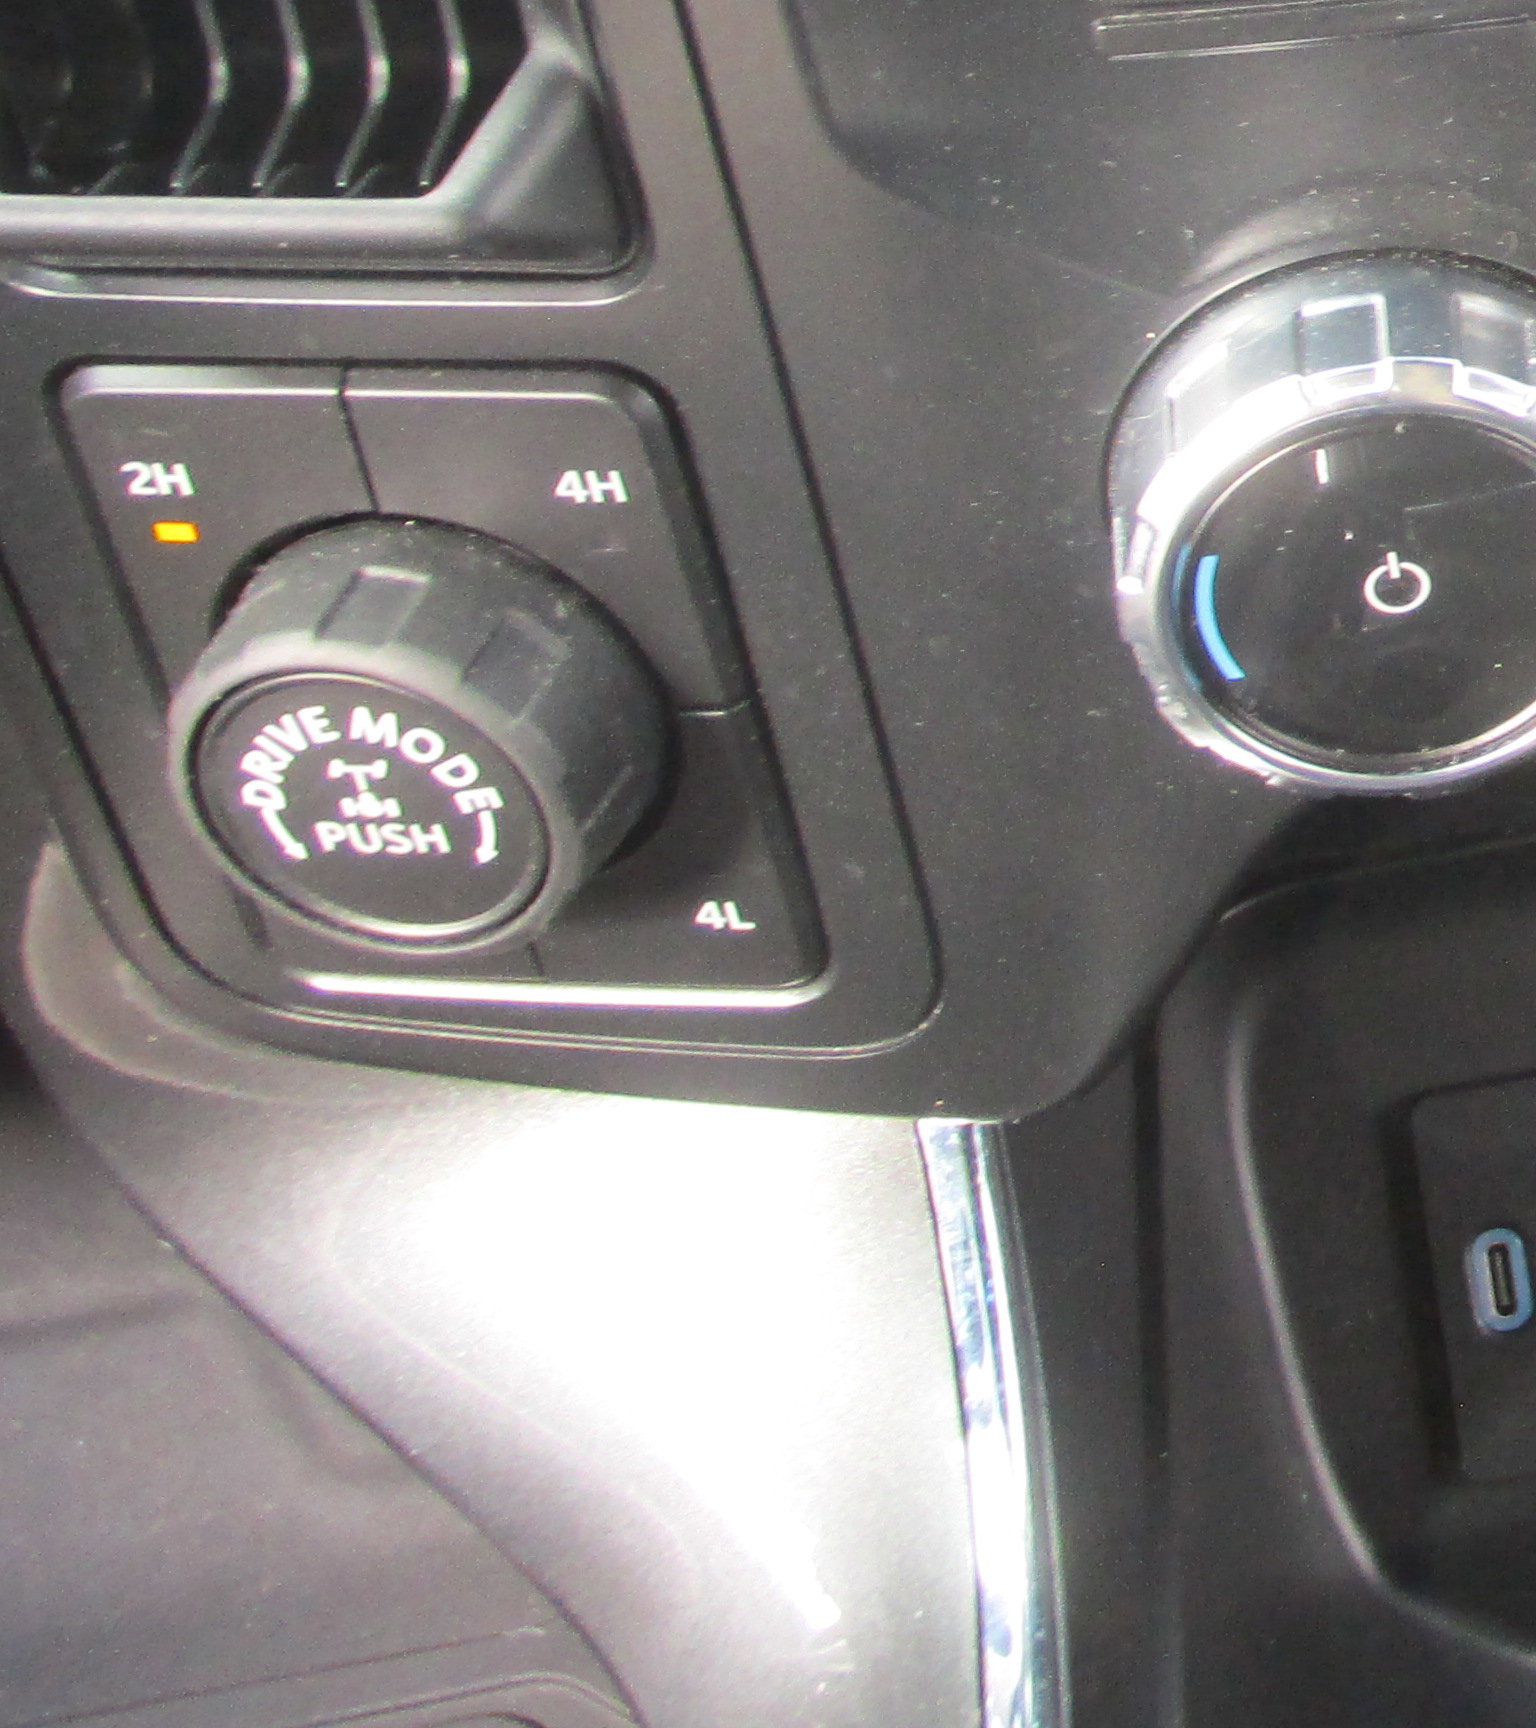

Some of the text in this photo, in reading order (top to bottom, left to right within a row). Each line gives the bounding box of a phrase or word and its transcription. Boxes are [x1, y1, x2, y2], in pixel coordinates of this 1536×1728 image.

[119, 461, 195, 497] 2H
[554, 469, 630, 504] 4H
[239, 704, 505, 816] DRIVE MODE
[313, 820, 452, 856] PUSH
[693, 899, 758, 932] 4L
